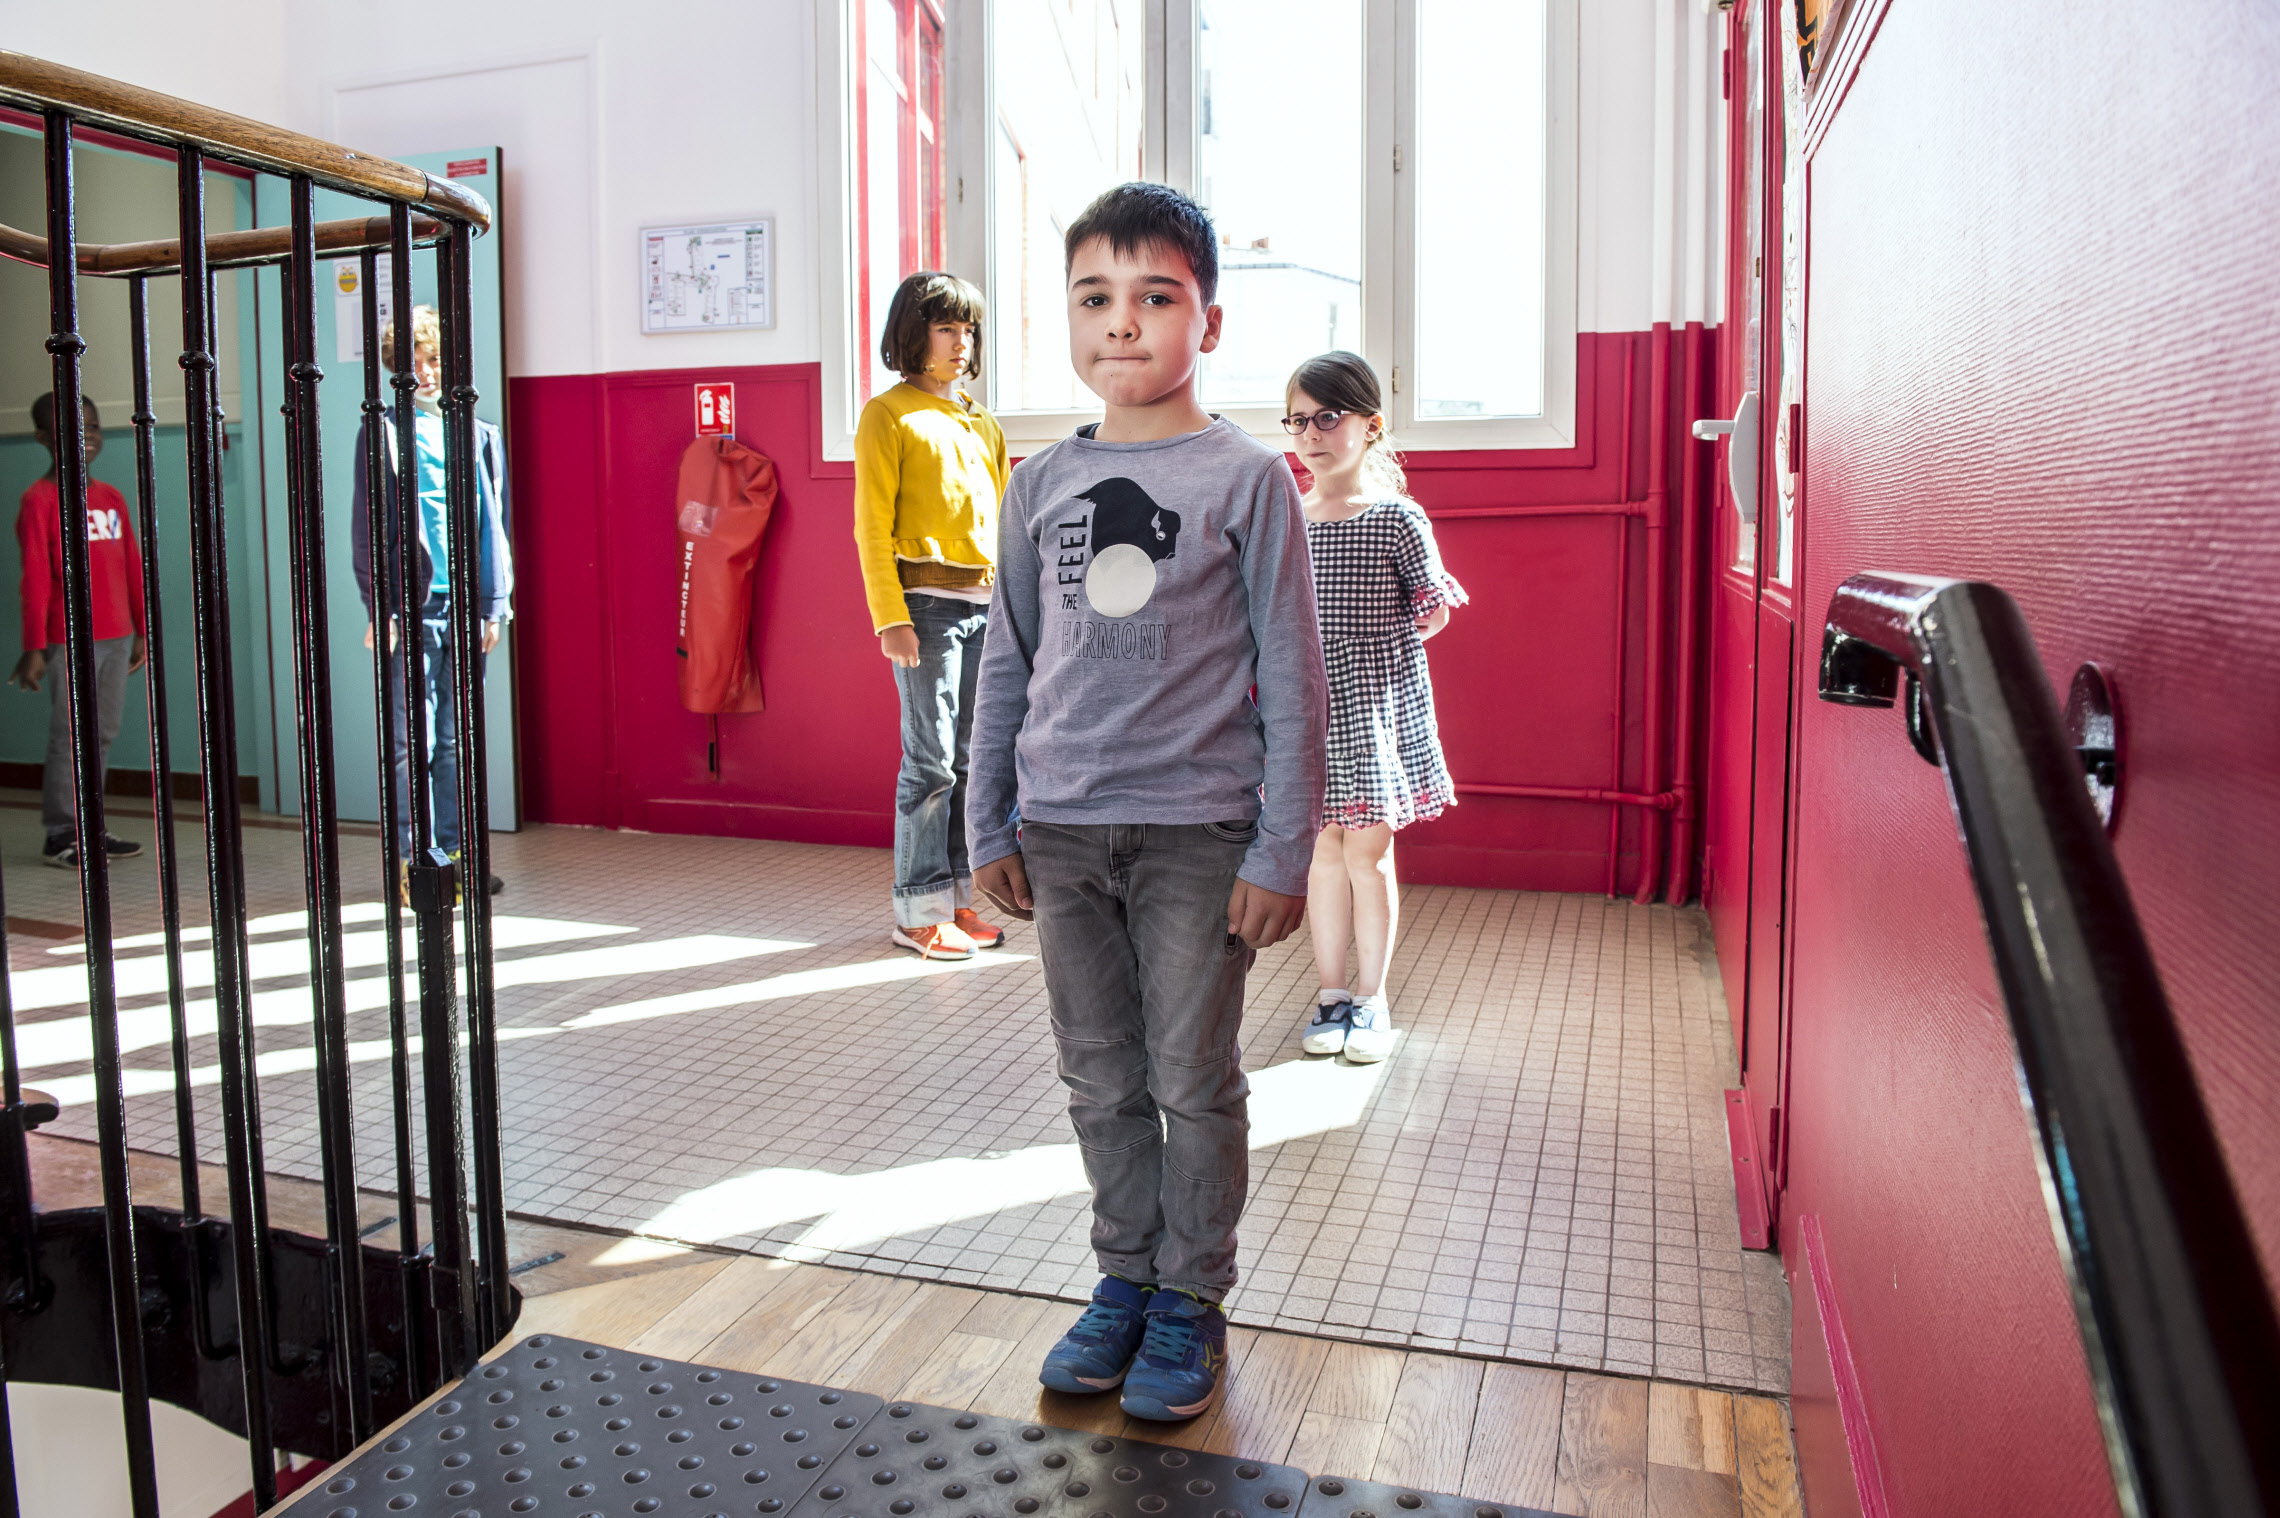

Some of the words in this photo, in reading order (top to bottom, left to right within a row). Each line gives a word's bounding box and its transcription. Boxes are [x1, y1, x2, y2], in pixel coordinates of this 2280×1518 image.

[1058, 514, 1088, 585] FEEL
[680, 541, 694, 637] EXTINCTEUR
[1062, 594, 1077, 610] THE
[1062, 621, 1172, 660] HARMONY
